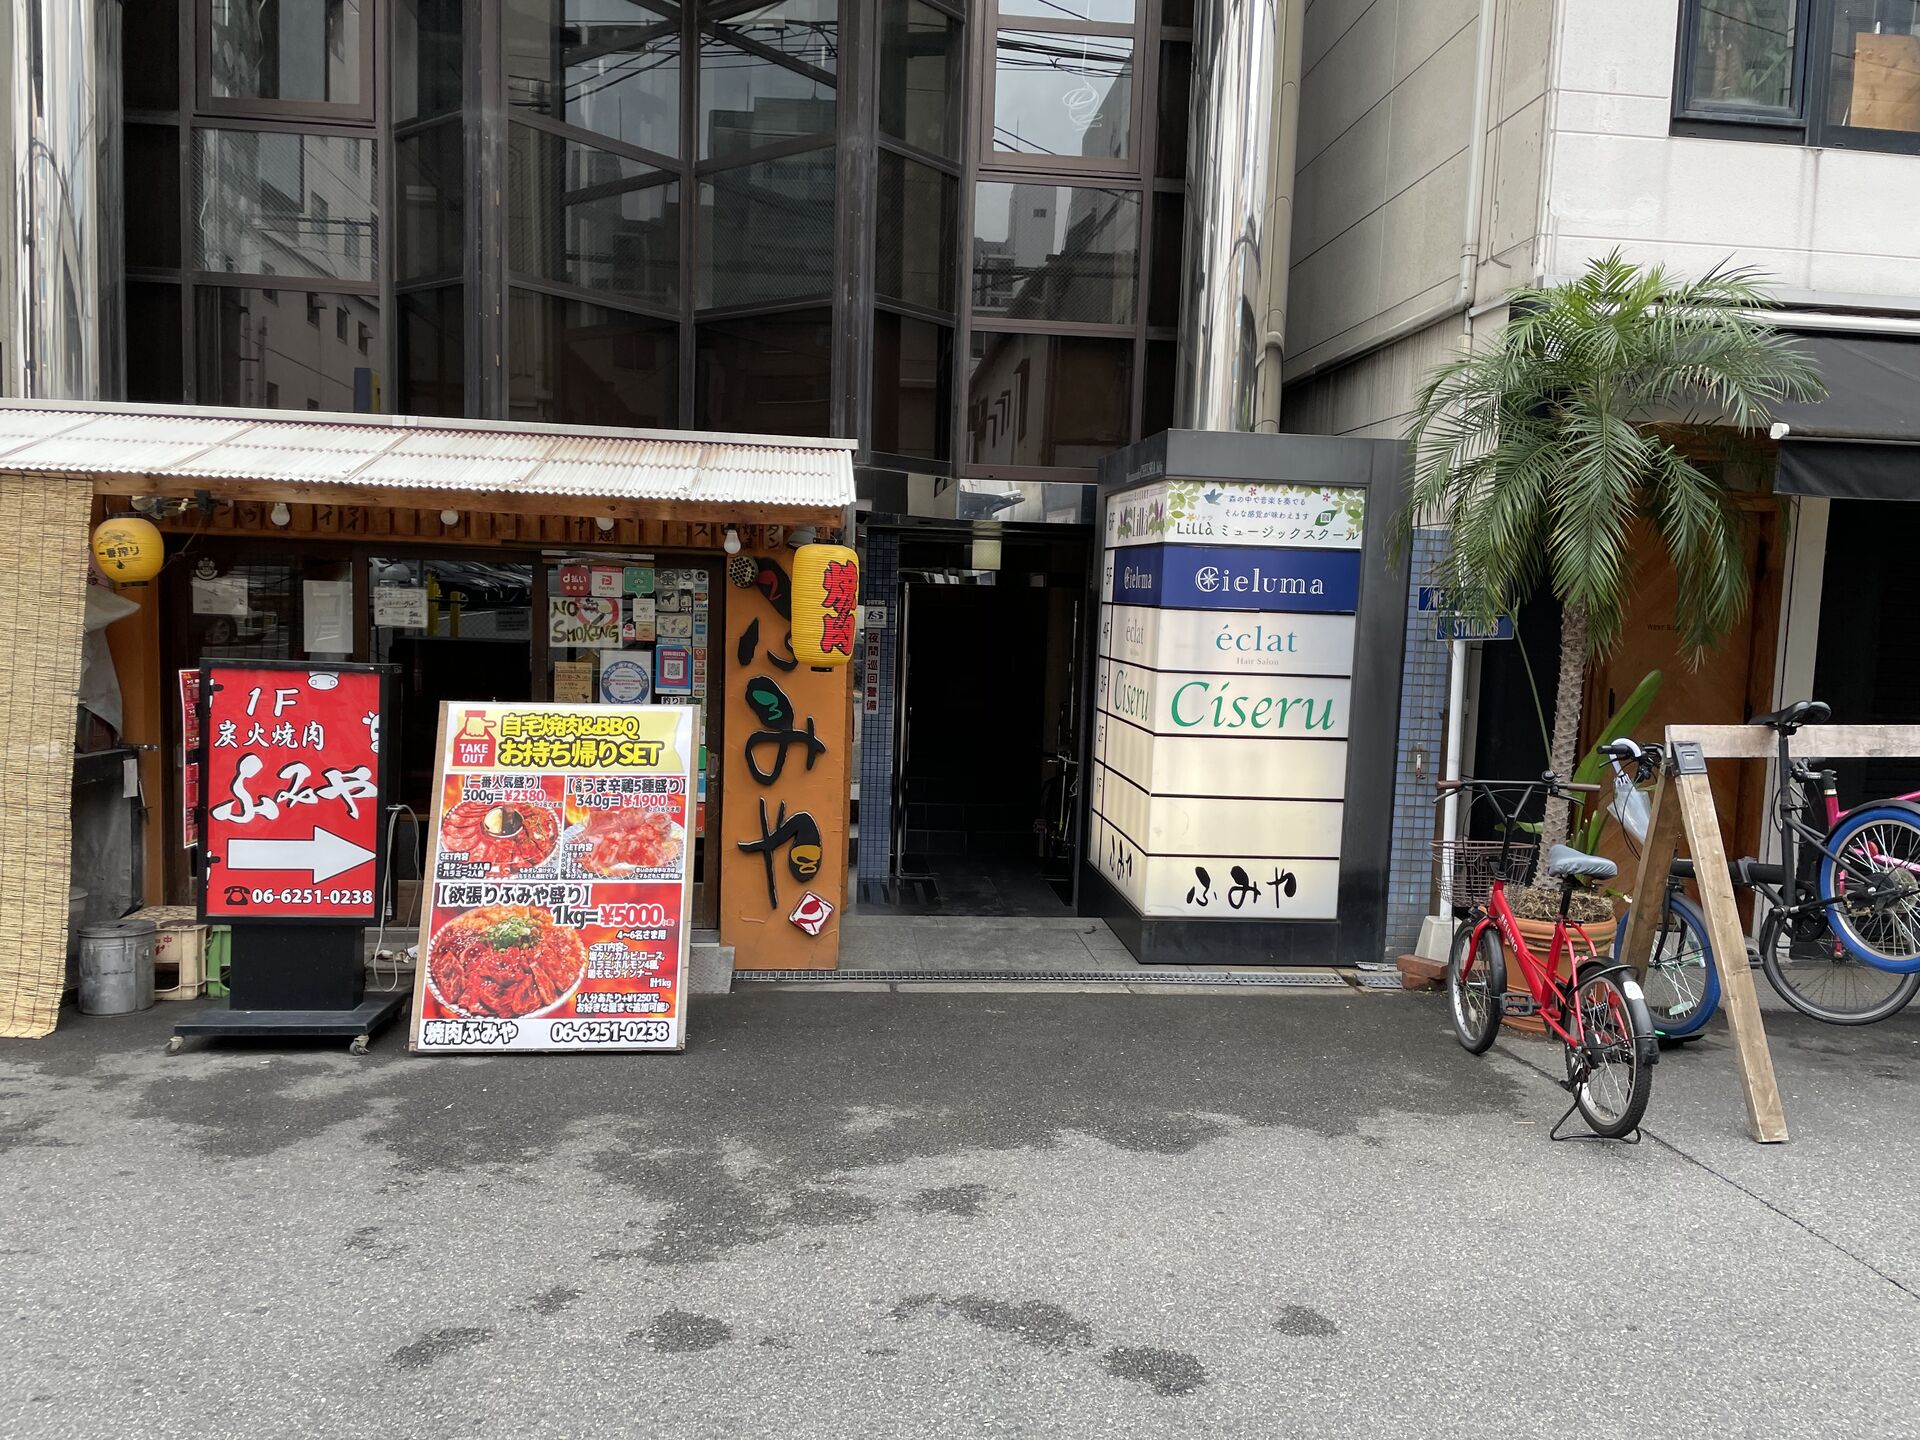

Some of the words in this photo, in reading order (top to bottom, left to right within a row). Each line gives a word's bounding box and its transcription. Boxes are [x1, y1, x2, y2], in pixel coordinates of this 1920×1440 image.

[1229, 495, 1306, 506] 森の中で音楽を奏でる
[1224, 509, 1309, 520] そんな感覚が味わえます
[1177, 521, 1214, 536] Lillà
[1221, 525, 1360, 541] ミュージックスクール
[562, 573, 587, 583] d払い
[1195, 565, 1325, 596] Cieluma
[551, 600, 580, 618] NO
[551, 620, 619, 643] SMOKING
[1216, 624, 1298, 652] éclat
[865, 632, 880, 711] 夜間巡回警備
[1237, 657, 1254, 665] Hair
[1257, 657, 1279, 666] Salon
[214, 720, 325, 750] 炭火焼肉
[501, 713, 640, 740] 自宅焼肉&BBQ
[459, 743, 488, 754] TAKE
[462, 753, 485, 764] OUT
[497, 739, 666, 767] お持ち帰りSET
[210, 753, 378, 823] ふみや
[462, 789, 546, 804] 300g=¥2380
[576, 794, 667, 809] 340g=¥1900
[440, 851, 470, 861] SET内容
[564, 843, 593, 852] SET内容
[252, 888, 373, 905] 06-6251-0238
[1186, 865, 1297, 909] ふみや
[552, 904, 664, 929] 1kg=¥5000
[425, 1021, 519, 1045] 焼肉ふみや
[550, 1021, 670, 1042] 06-6251-0238
